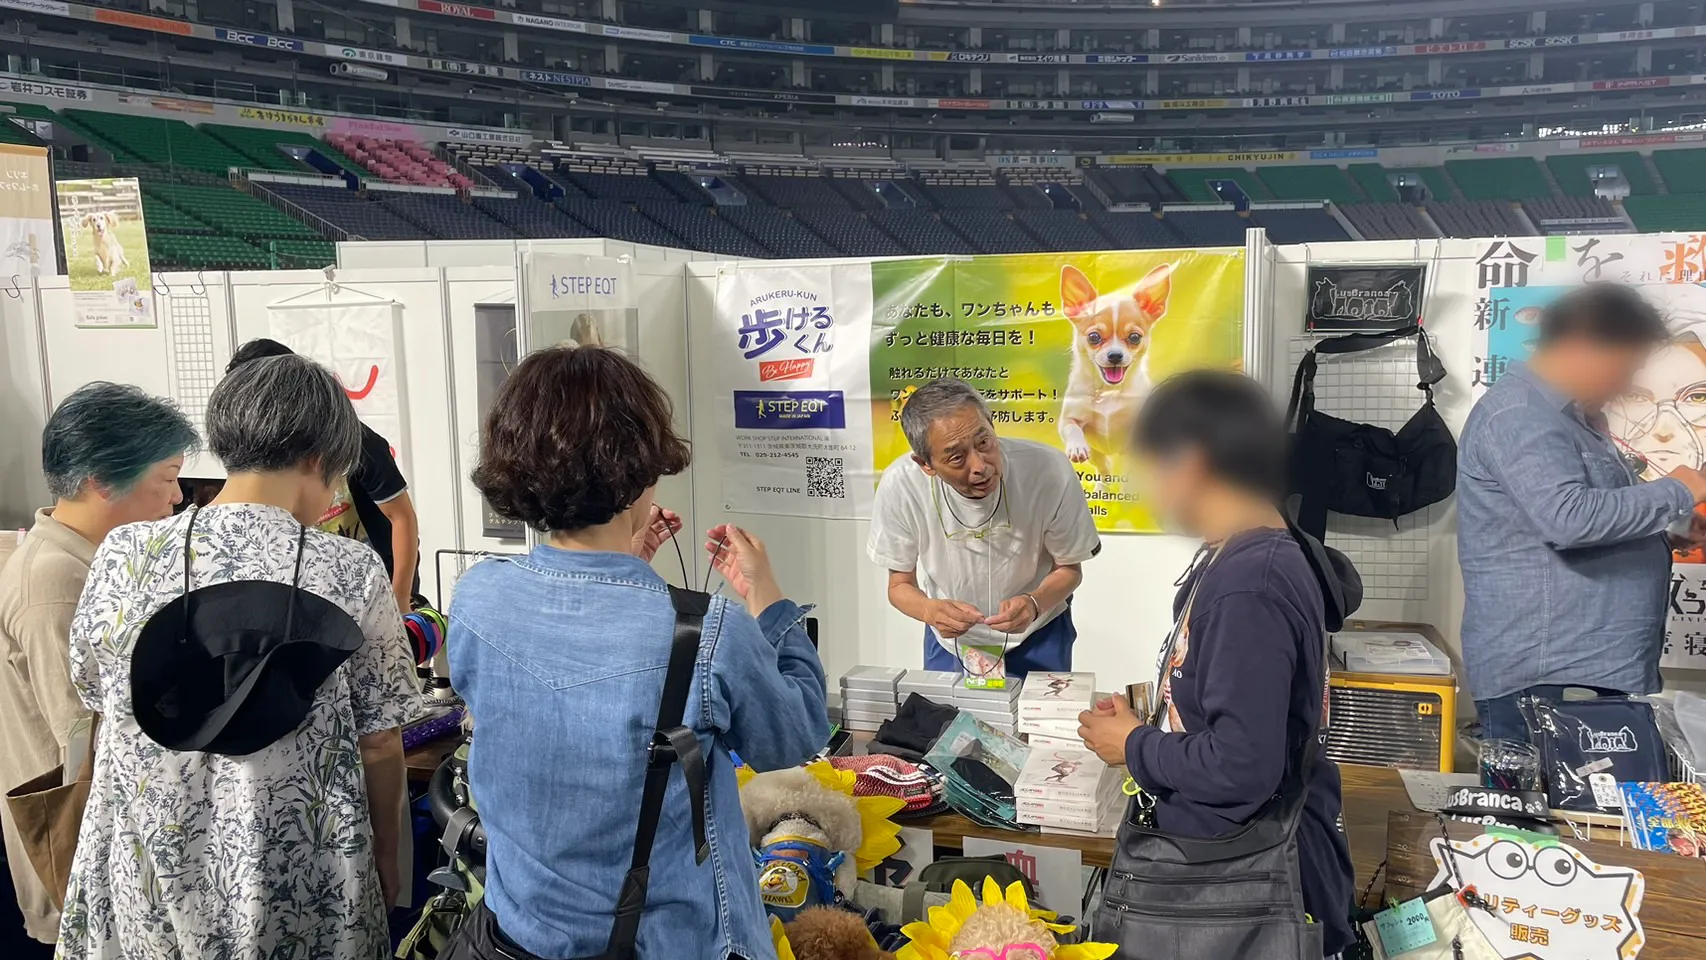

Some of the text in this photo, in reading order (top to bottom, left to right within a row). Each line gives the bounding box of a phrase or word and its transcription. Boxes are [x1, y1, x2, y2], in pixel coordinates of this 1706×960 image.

[440, 3, 474, 17] ROYAL
[525, 16, 581, 29] NAGANO INTERIOR
[226, 31, 294, 50] BCC BCC
[719, 39, 736, 47] CTC
[1509, 36, 1572, 48] SCSK SCSK
[529, 72, 591, 85] ネスト NESTPIA
[11, 82, 88, 100] 岩井コスモ証券
[1430, 90, 1460, 99] TOTO
[1228, 153, 1284, 161] CHIKYUJIN
[561, 276, 617, 295] STEP EQT
[750, 290, 818, 307] ARUKERU-KUN
[887, 302, 1056, 319] あなたも、ワンちゃんも
[738, 306, 834, 360] 歩ける
[885, 330, 1035, 347] ずっと健康な毎日を！
[794, 332, 834, 354] くん
[768, 400, 825, 413] STEP EQT
[1076, 471, 1101, 482] You
[1483, 892, 1623, 934] リティーグッズ
[1510, 921, 1550, 947] 販売
